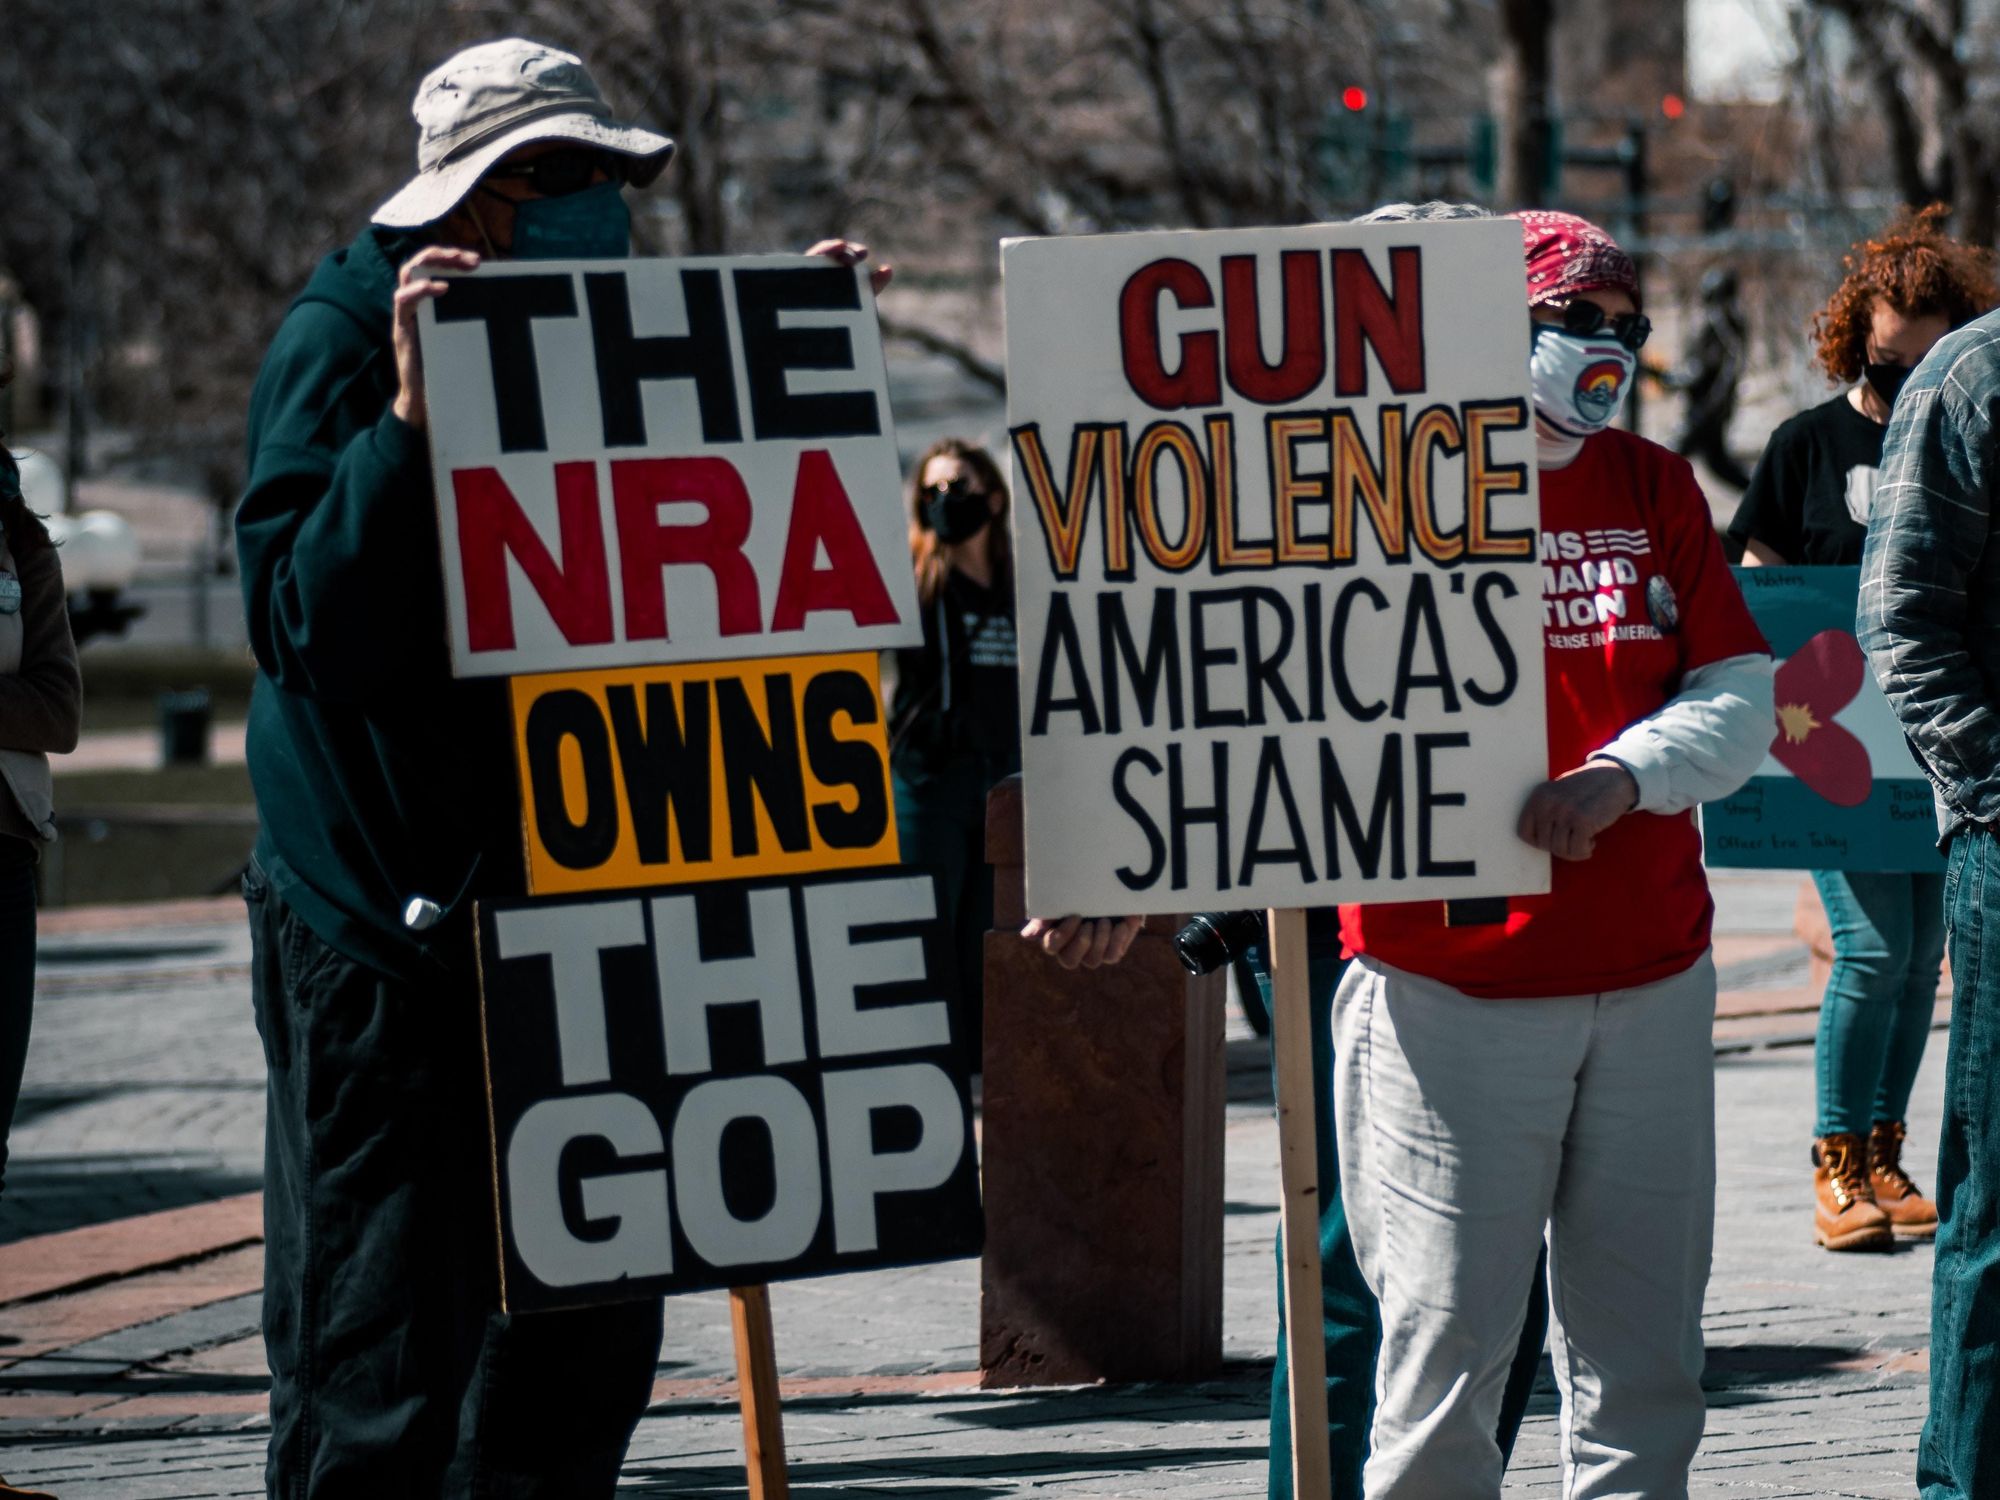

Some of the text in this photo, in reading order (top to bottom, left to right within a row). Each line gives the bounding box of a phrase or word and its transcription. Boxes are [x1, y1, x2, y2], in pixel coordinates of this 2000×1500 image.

[432, 267, 882, 454] THE
[1118, 245, 1426, 411] GUN
[451, 449, 901, 653] NRA
[1009, 397, 1537, 583] VIOLENCE
[1030, 571, 1519, 736] AMERICA'S
[1548, 632, 1591, 650] SENSE
[1591, 630, 1608, 648] IN
[525, 670, 889, 871] OWNS
[1111, 731, 1476, 891] SHAME
[495, 875, 951, 1087] THE
[507, 1062, 965, 1288] GOP
